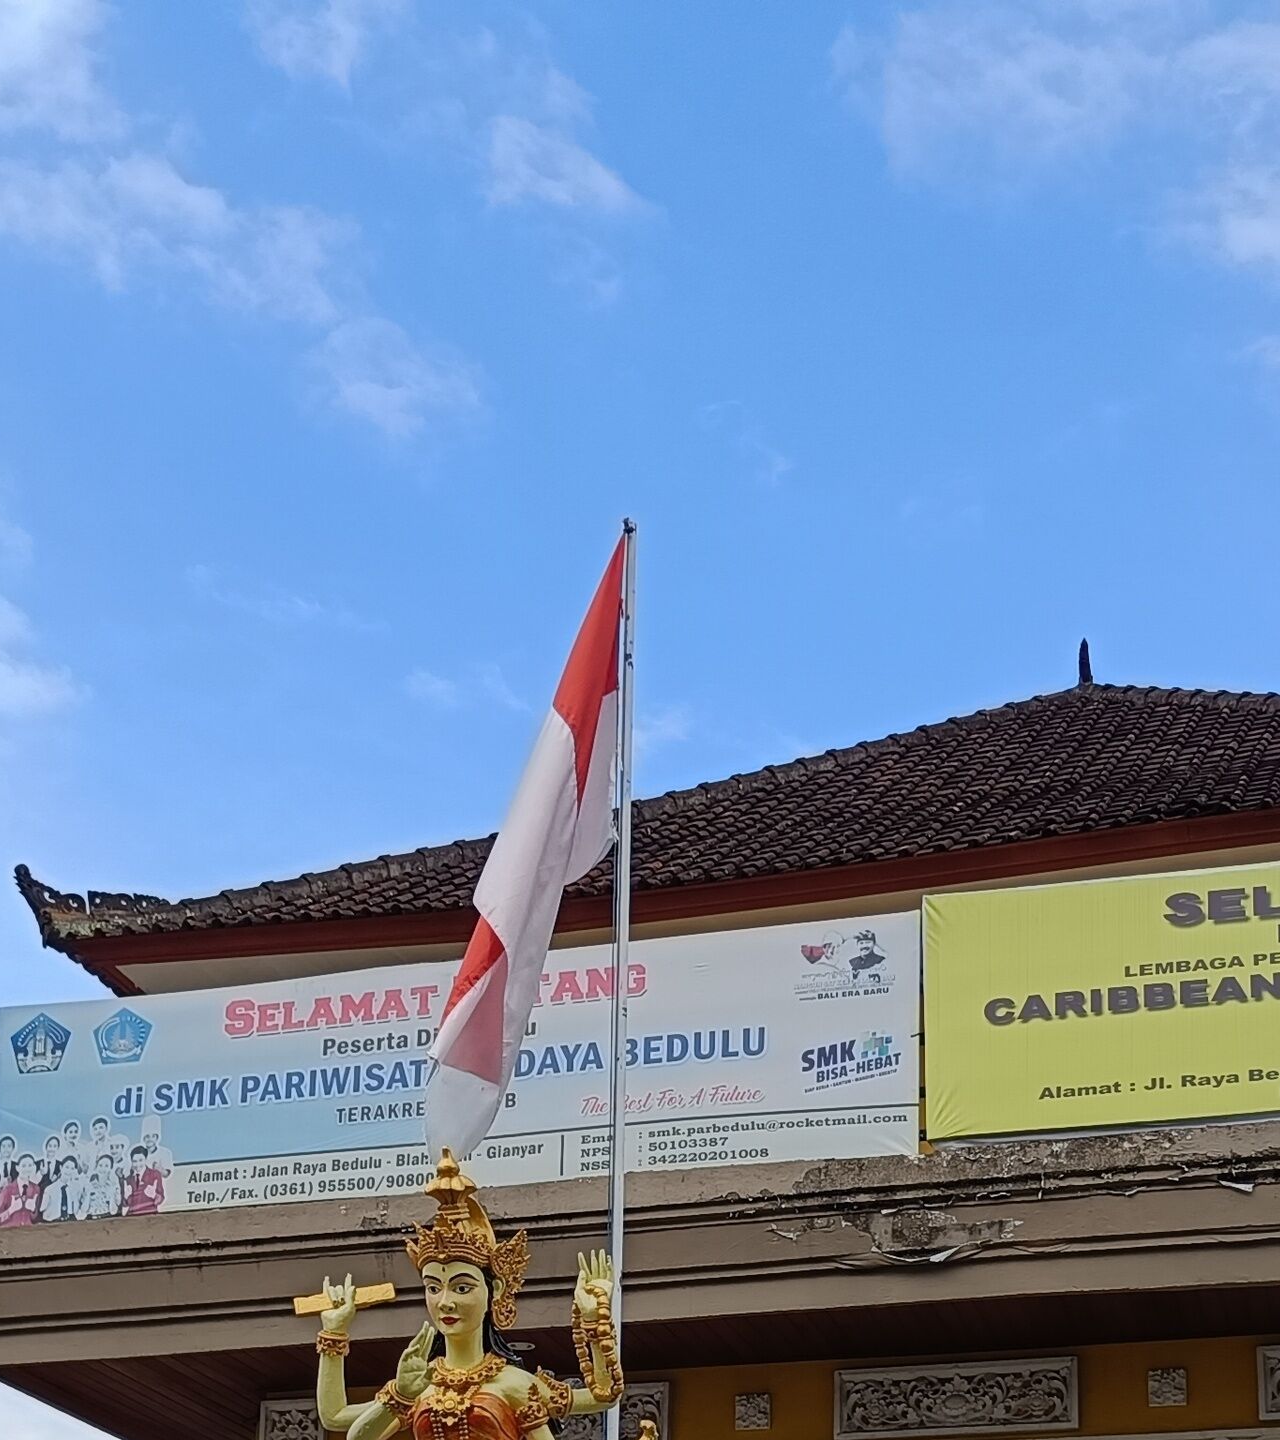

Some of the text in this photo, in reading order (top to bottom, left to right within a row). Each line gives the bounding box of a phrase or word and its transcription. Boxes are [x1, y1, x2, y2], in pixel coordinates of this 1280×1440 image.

[1124, 956, 1245, 978] LEMBAGA
[817, 991, 839, 1000] BALI
[842, 990, 860, 998] ERA
[863, 987, 889, 996] BARU
[223, 985, 439, 1038] SELAMAT
[322, 1032, 409, 1056] Peserta
[801, 1039, 857, 1073] SMK
[114, 1086, 144, 1115] di
[153, 1077, 231, 1112] SMK
[514, 1042, 604, 1078] DAYA
[815, 1052, 902, 1084] BISA-HEBAT
[580, 1096, 609, 1114] The
[658, 1088, 685, 1108] For
[690, 1087, 705, 1105] A
[709, 1084, 764, 1103] Future
[1038, 1080, 1122, 1100] Alamat
[1180, 1072, 1240, 1089] Raya
[336, 1101, 426, 1123] TERAKRE
[580, 1134, 614, 1145] Ema
[648, 1114, 909, 1138] smk.parbedulu@rocketmail.com
[486, 1143, 545, 1159] Gianyar
[580, 1146, 611, 1159] NPS
[648, 1136, 729, 1152] 50103387
[648, 1148, 769, 1165] 342220201008
[187, 1167, 239, 1184] Alamat
[250, 1164, 289, 1179] Jalan
[292, 1161, 327, 1177] Raya
[331, 1156, 382, 1172] Bedulu
[187, 1172, 435, 1204] Telp./Fax. (0361) 955500/90800
